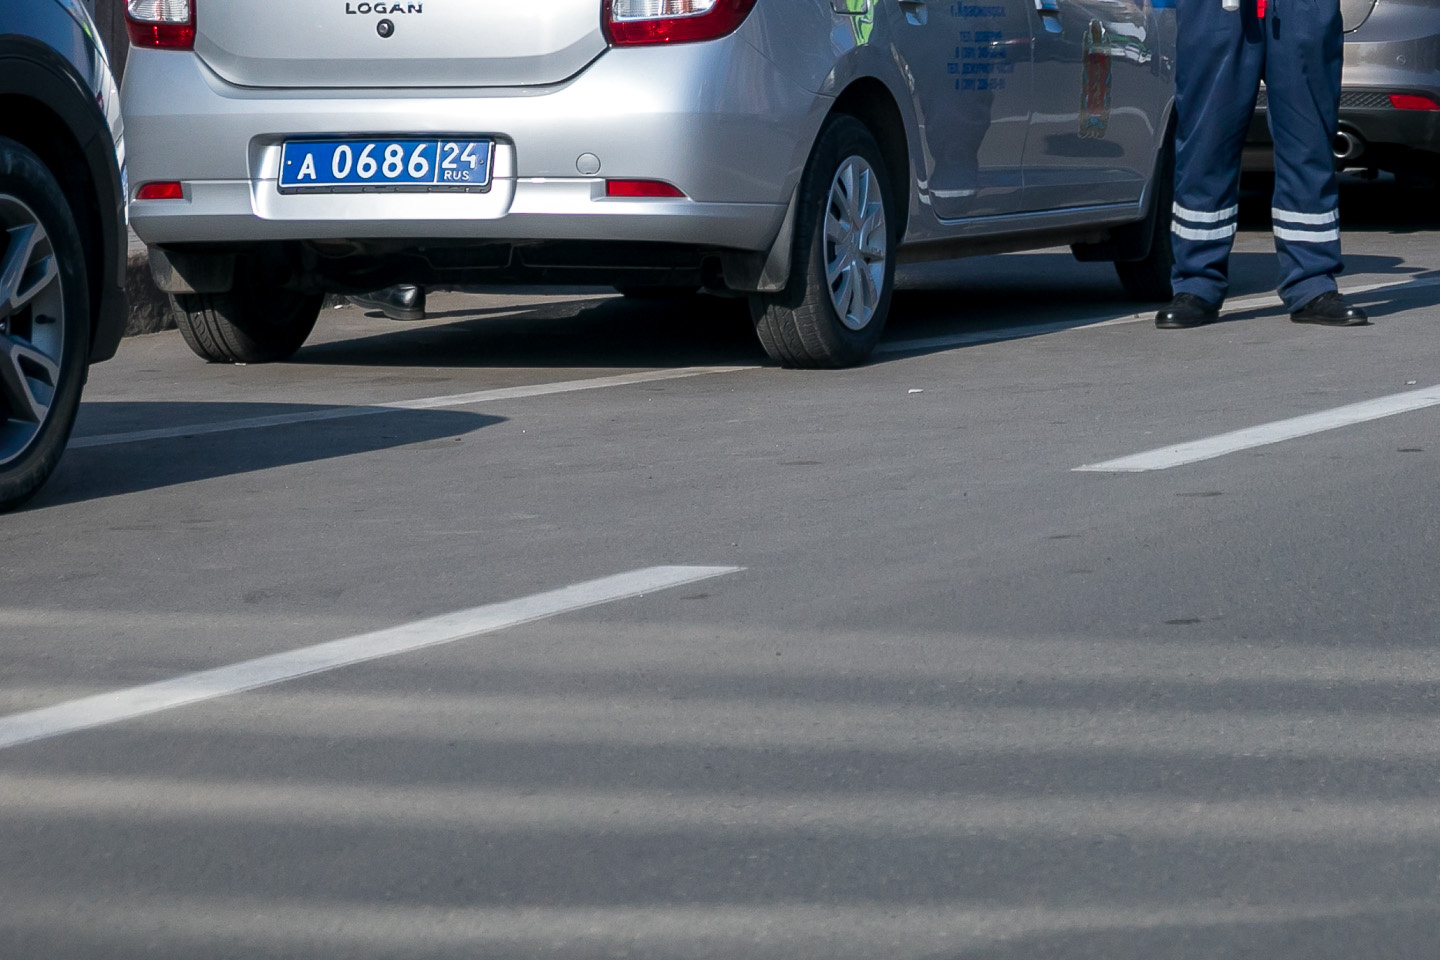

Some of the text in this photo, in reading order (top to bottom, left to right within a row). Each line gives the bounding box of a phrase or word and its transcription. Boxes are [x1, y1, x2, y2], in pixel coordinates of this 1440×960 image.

[345, 1, 423, 15] LOGAN
[297, 142, 477, 180] А 0686 24
[444, 170, 470, 181] RUS
